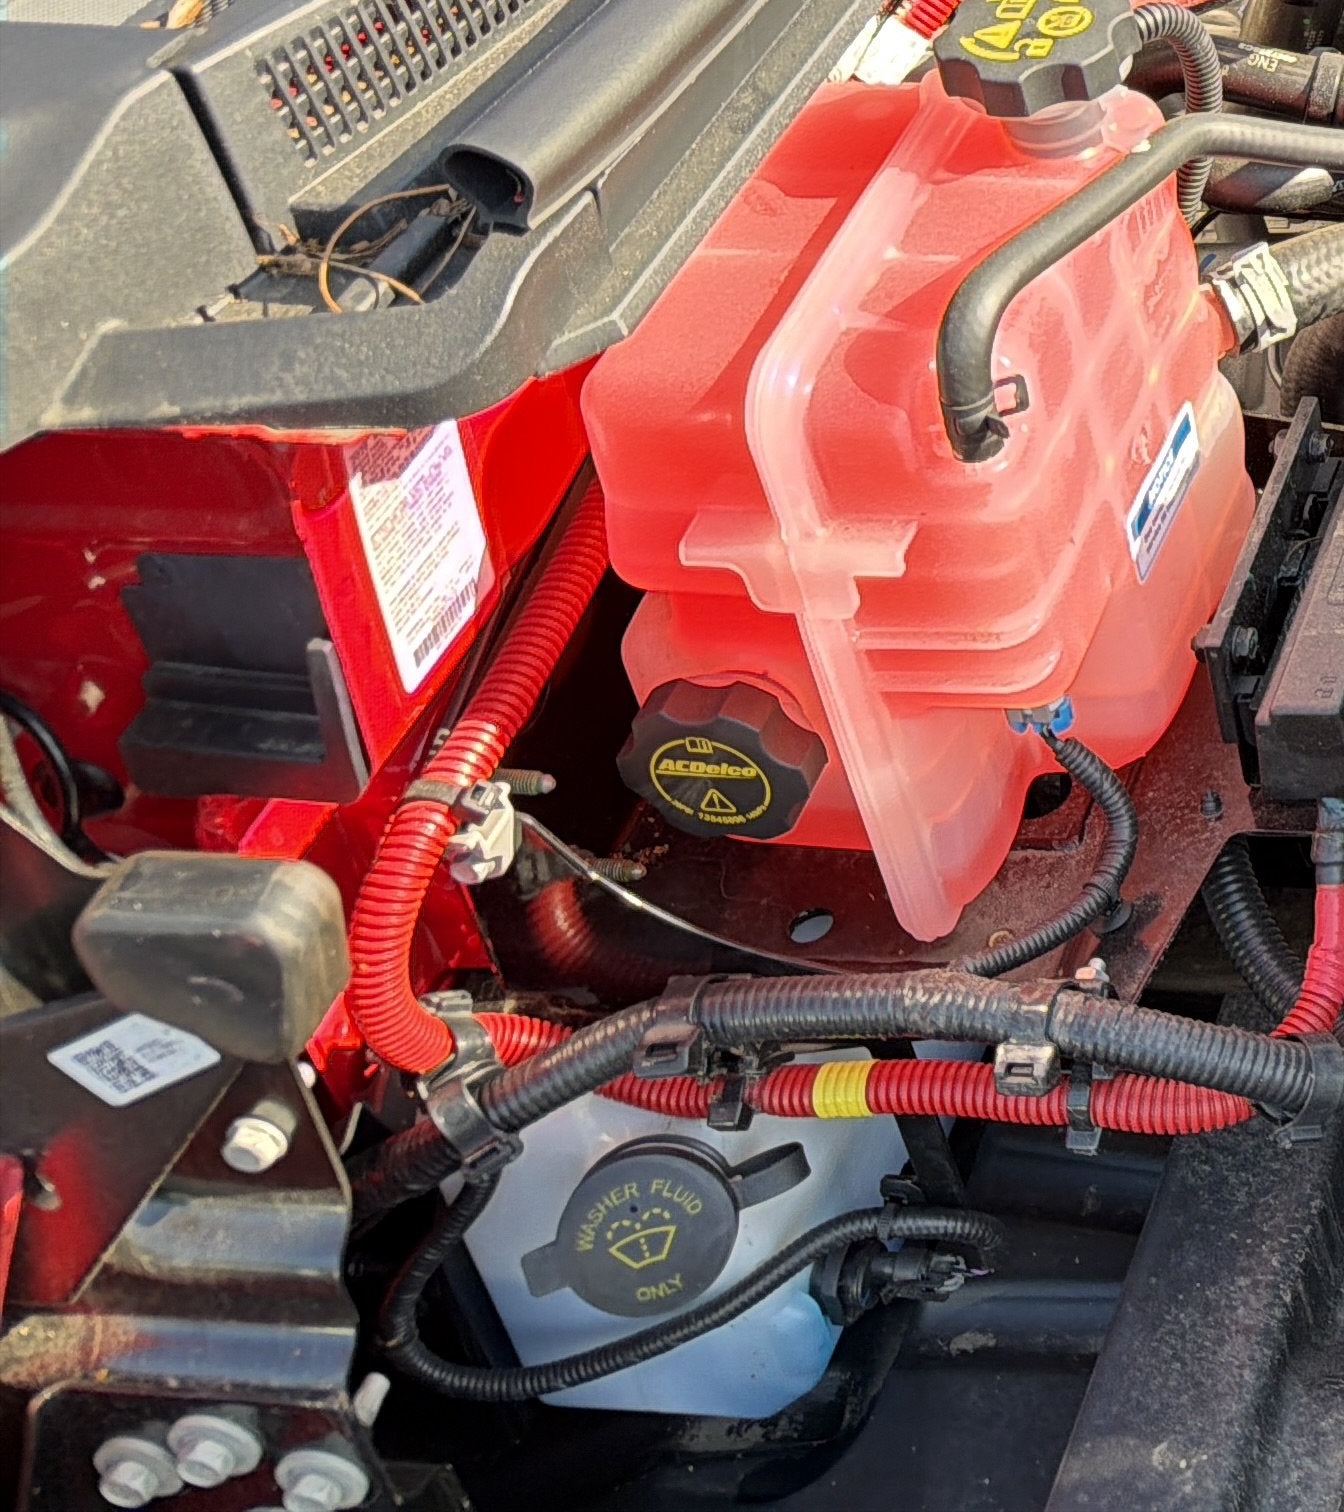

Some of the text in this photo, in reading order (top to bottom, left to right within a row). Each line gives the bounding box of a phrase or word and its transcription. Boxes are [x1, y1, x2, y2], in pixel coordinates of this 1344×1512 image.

[1247, 53, 1279, 73] ENG
[658, 758, 757, 778] ACDelco
[576, 1178, 703, 1252] WASHER FLUID
[636, 1272, 684, 1303] ONLY
